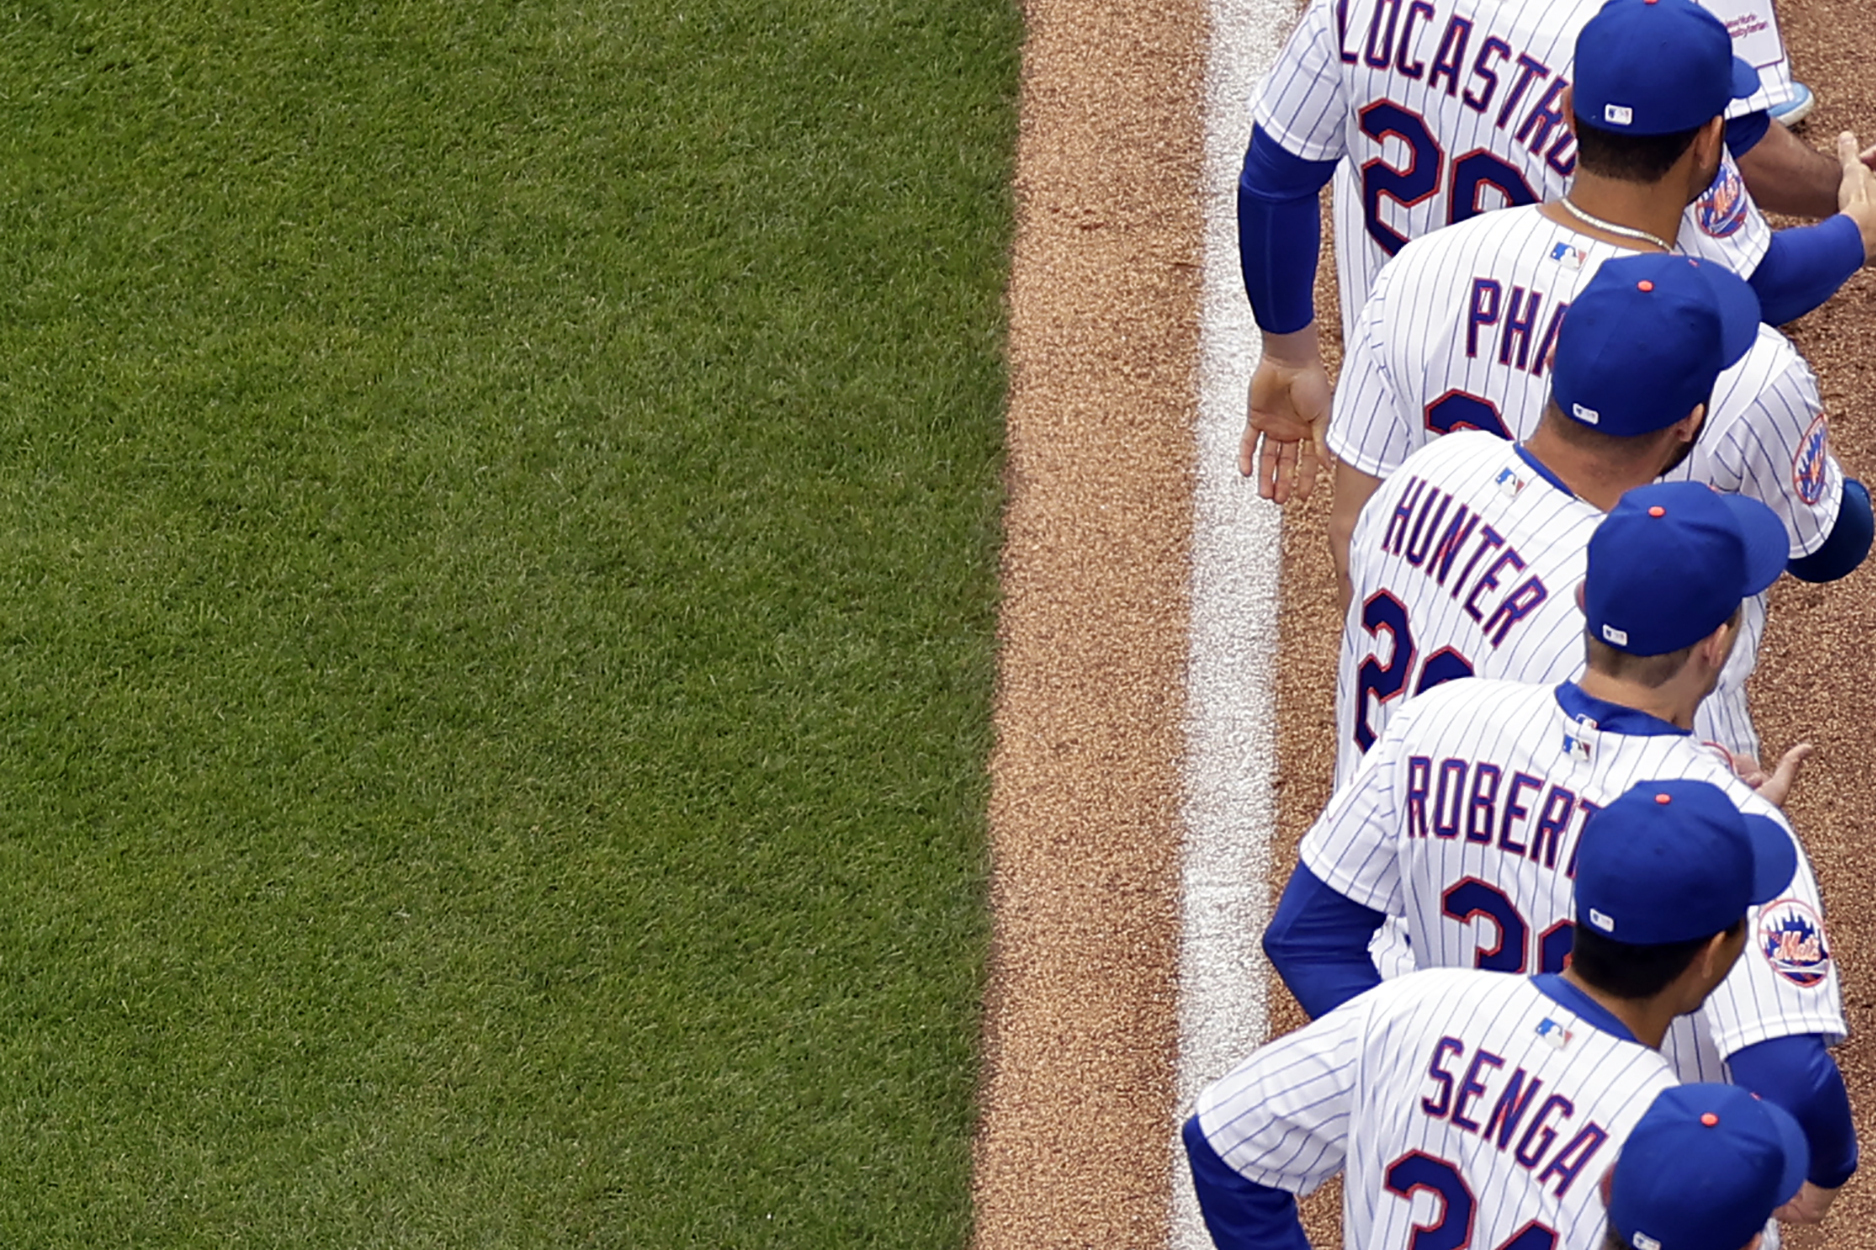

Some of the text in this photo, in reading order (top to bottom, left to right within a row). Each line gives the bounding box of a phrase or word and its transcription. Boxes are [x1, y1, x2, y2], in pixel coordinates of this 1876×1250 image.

[1380, 474, 1548, 651] HUNTER
[1353, 587, 1476, 756] 2
[1384, 1148, 1560, 1250] 3
[1421, 1035, 1609, 1200] SENGA
